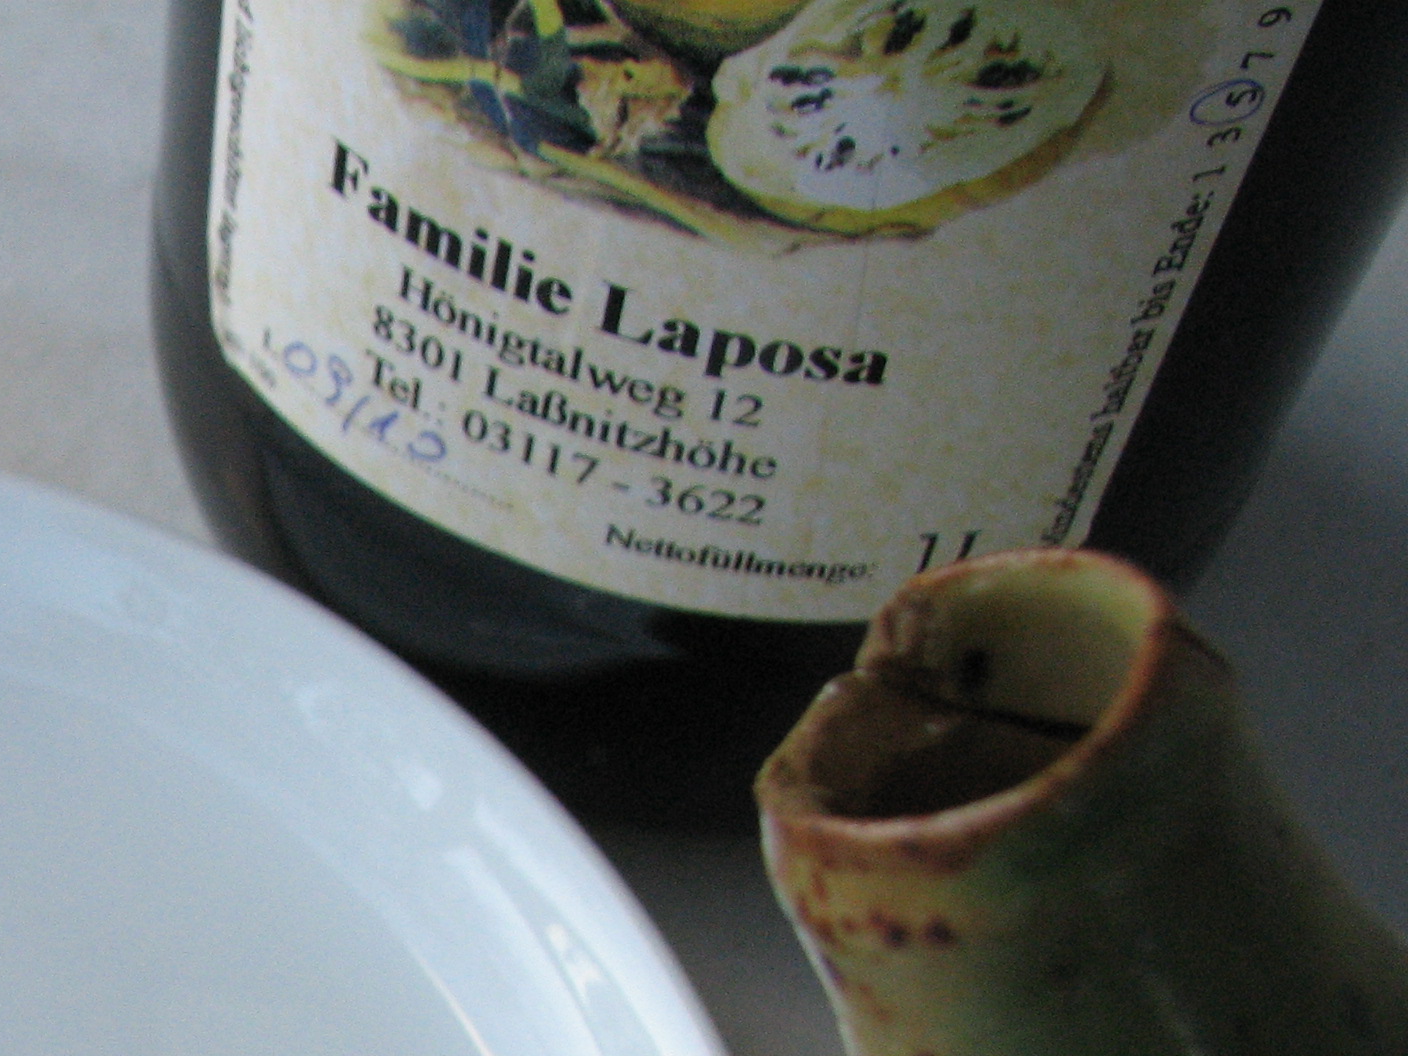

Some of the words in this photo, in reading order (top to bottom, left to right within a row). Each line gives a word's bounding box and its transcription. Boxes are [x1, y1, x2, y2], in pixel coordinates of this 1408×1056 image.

[1257, 6, 1292, 28] 9
[1239, 50, 1275, 70] 7
[1225, 87, 1259, 108] 5
[1206, 126, 1242, 148] 3
[1193, 164, 1227, 182] 1
[1152, 190, 1215, 278] Ende:
[330, 136, 574, 315] Familie
[600, 280, 890, 386] Laposa
[1130, 279, 1176, 325] bis
[398, 264, 686, 419] Hönigtalweg
[710, 388, 765, 427] 12
[373, 303, 463, 383] 8301
[484, 365, 779, 479] Laßnitzhöhe
[463, 409, 600, 485] 03117
[645, 475, 767, 526] 3622
